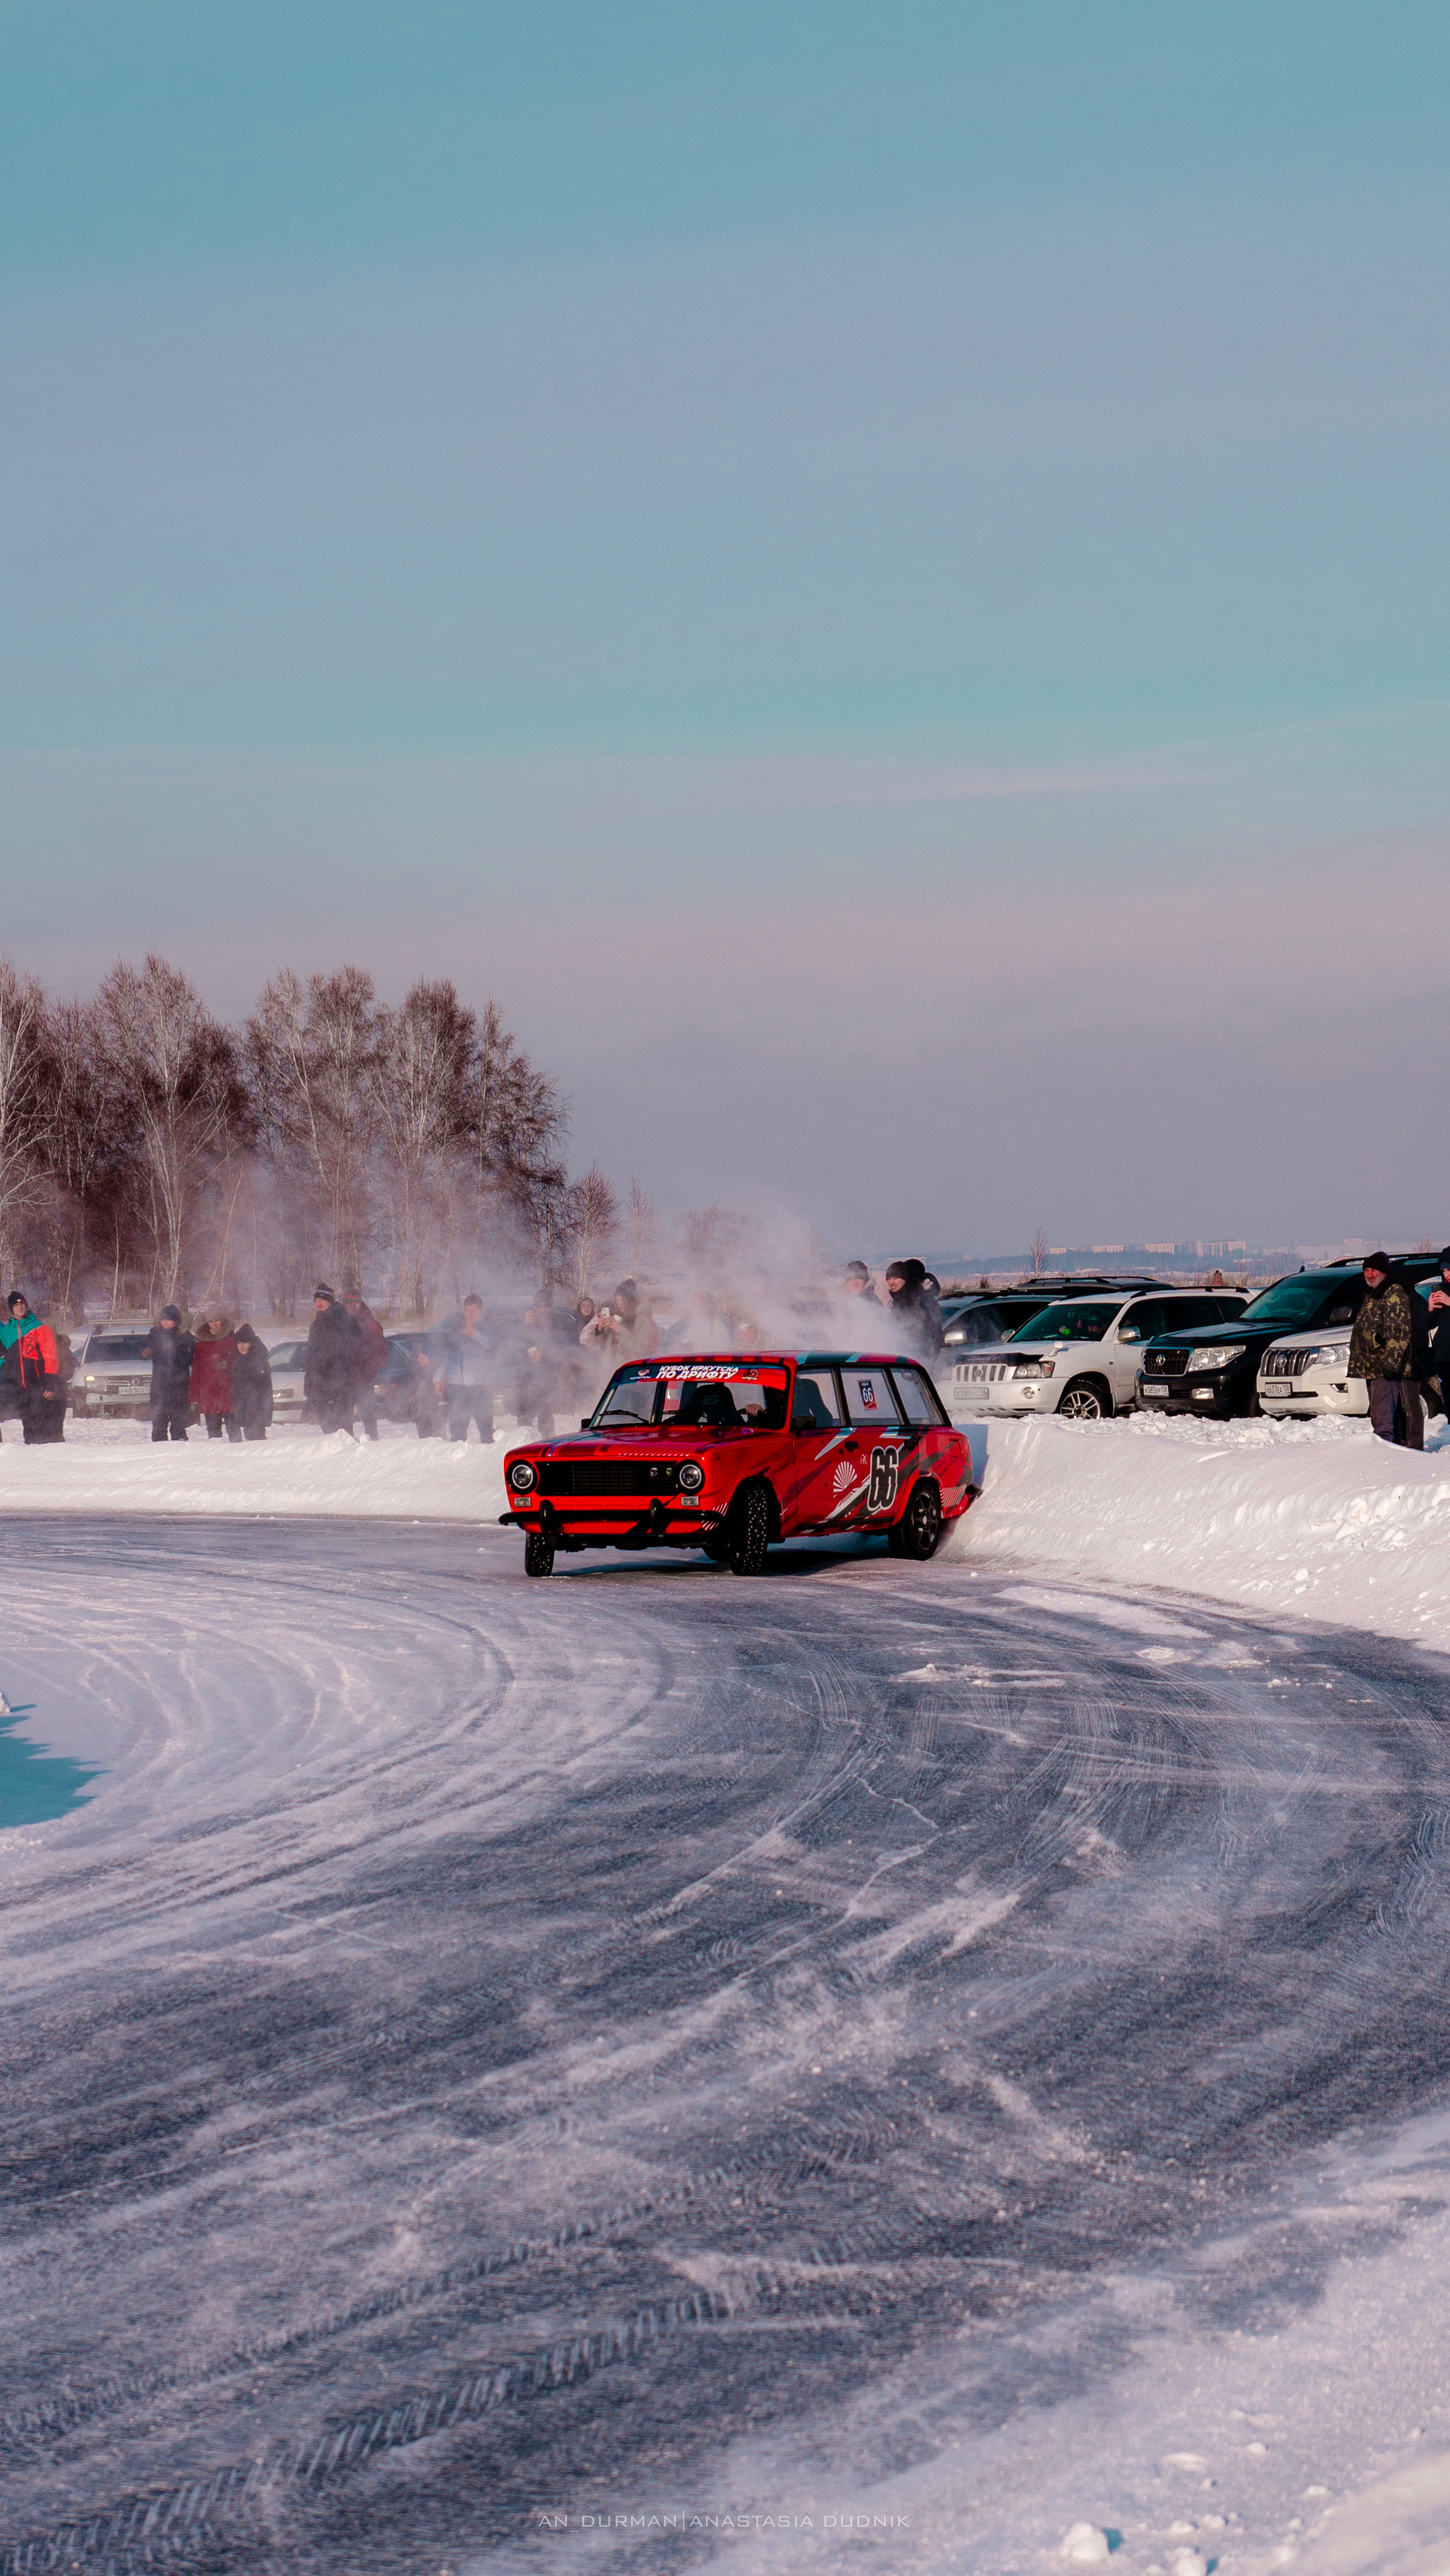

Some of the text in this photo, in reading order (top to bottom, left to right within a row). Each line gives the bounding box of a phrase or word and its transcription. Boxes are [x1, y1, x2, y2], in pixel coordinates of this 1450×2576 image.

[655, 1371, 677, 1379] ПО
[676, 1371, 737, 1380] ДРИФТУ
[862, 1387, 874, 1403] 66
[867, 1445, 899, 1511] 66
